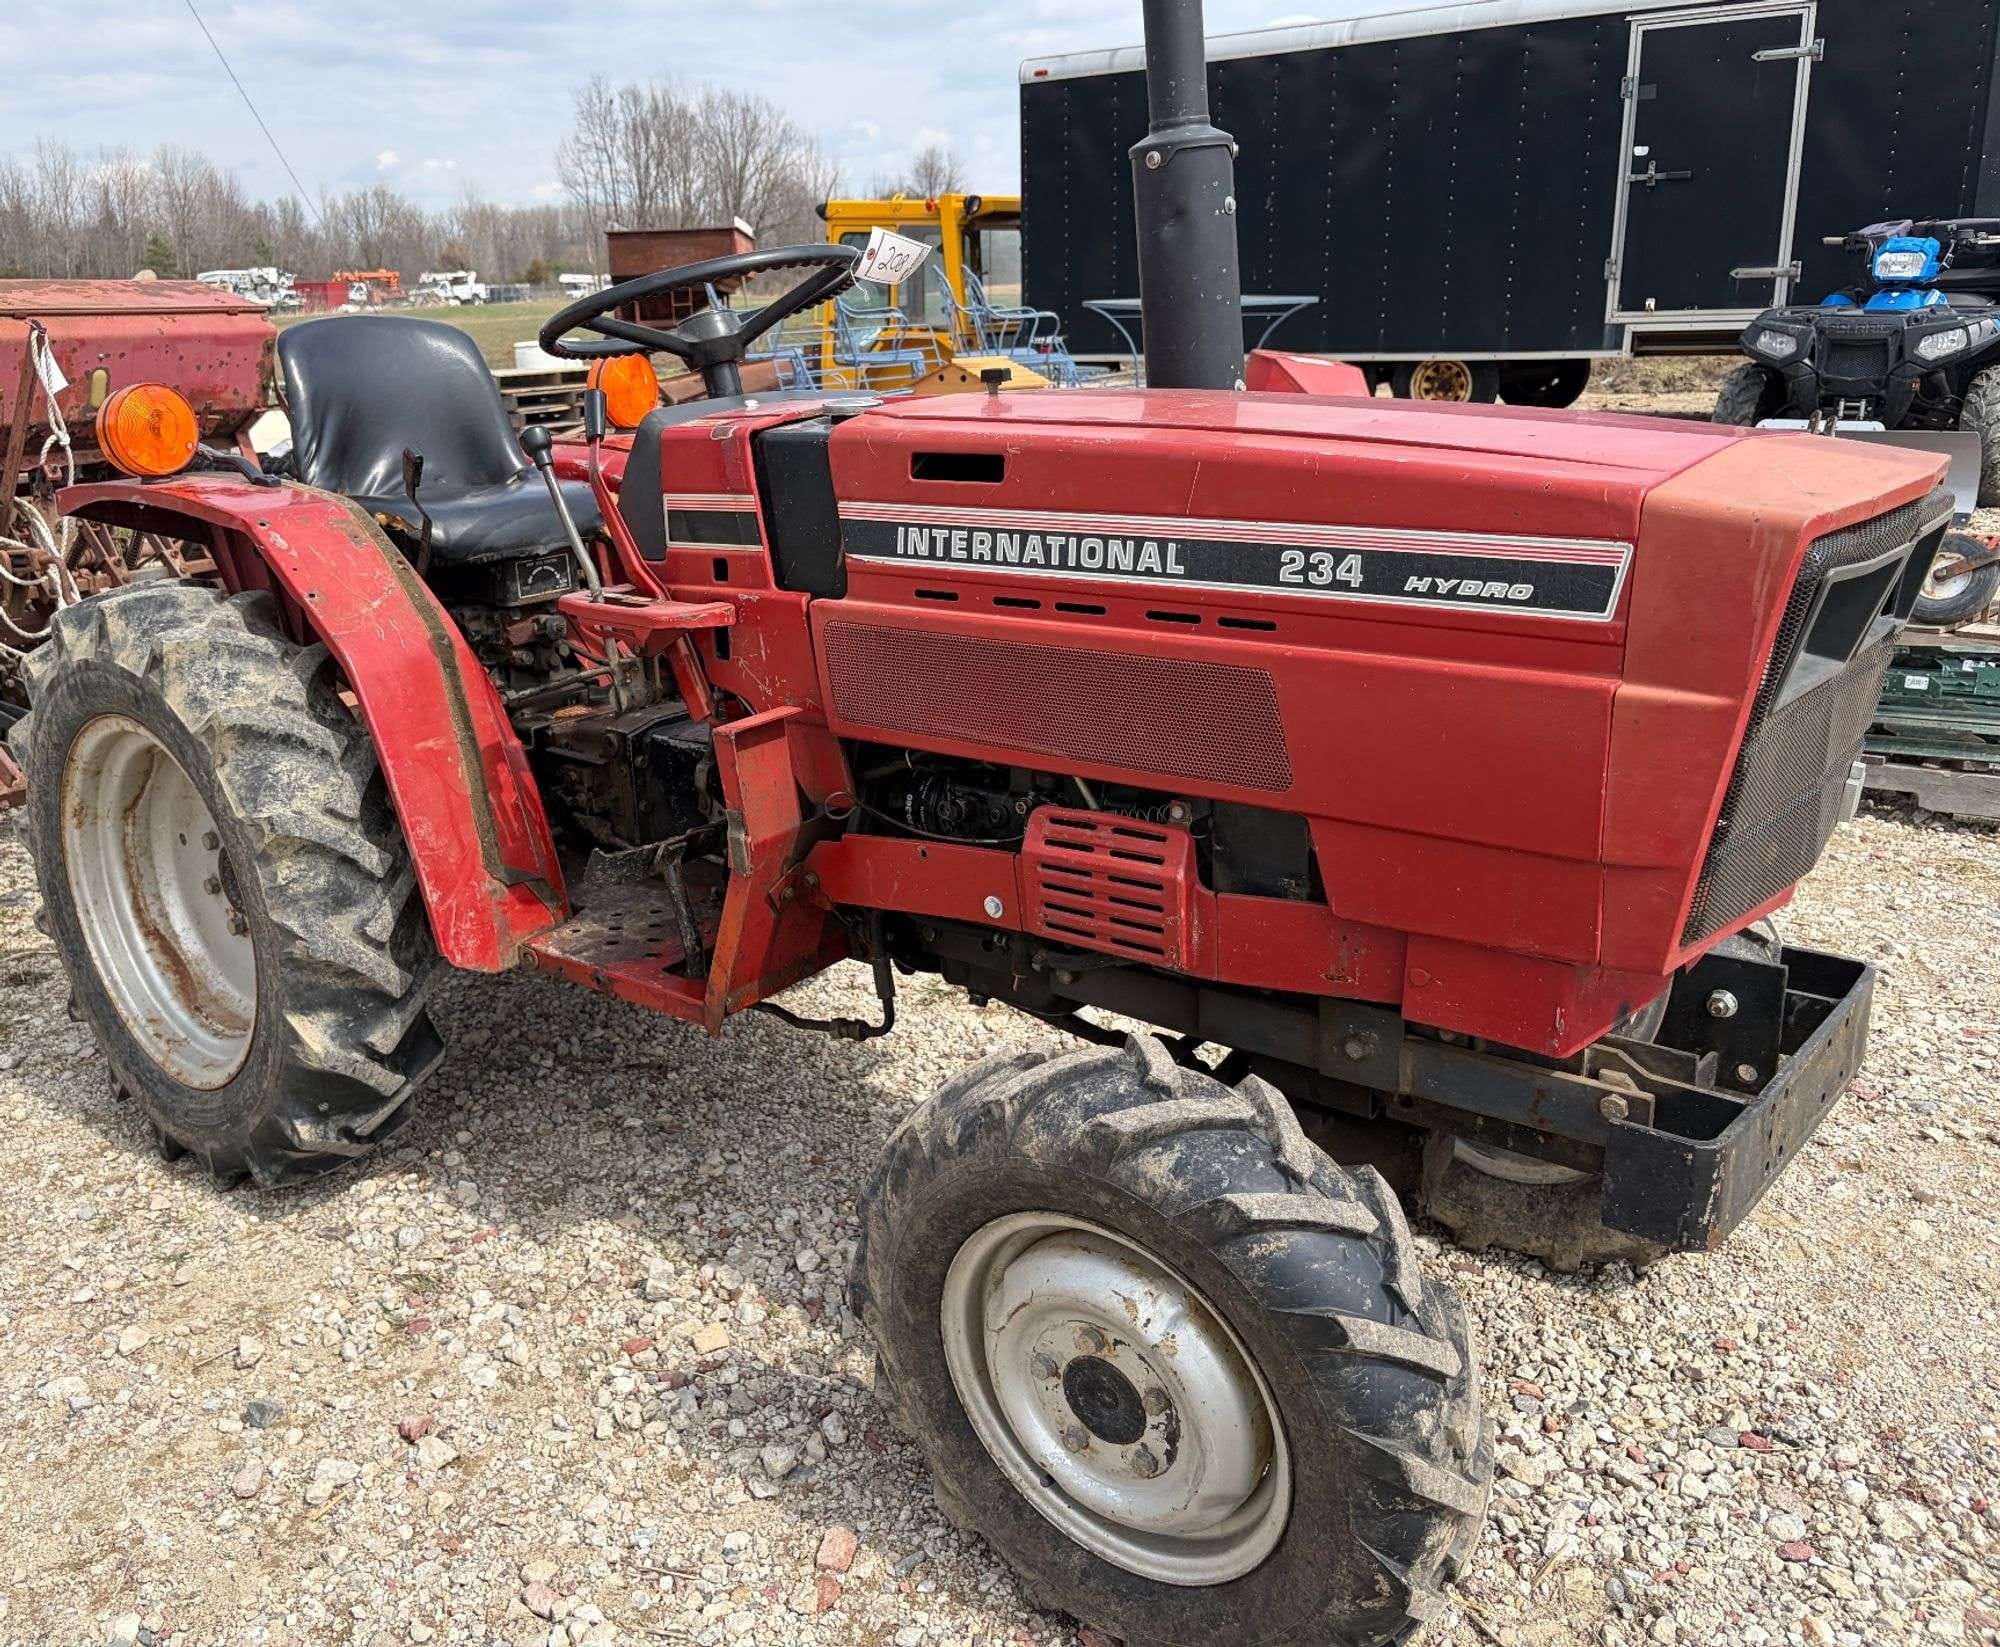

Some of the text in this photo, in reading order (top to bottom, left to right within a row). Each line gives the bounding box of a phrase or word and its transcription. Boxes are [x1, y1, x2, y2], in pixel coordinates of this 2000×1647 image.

[896, 526, 1534, 600] INTERNATIONAL 234 HYDRO
